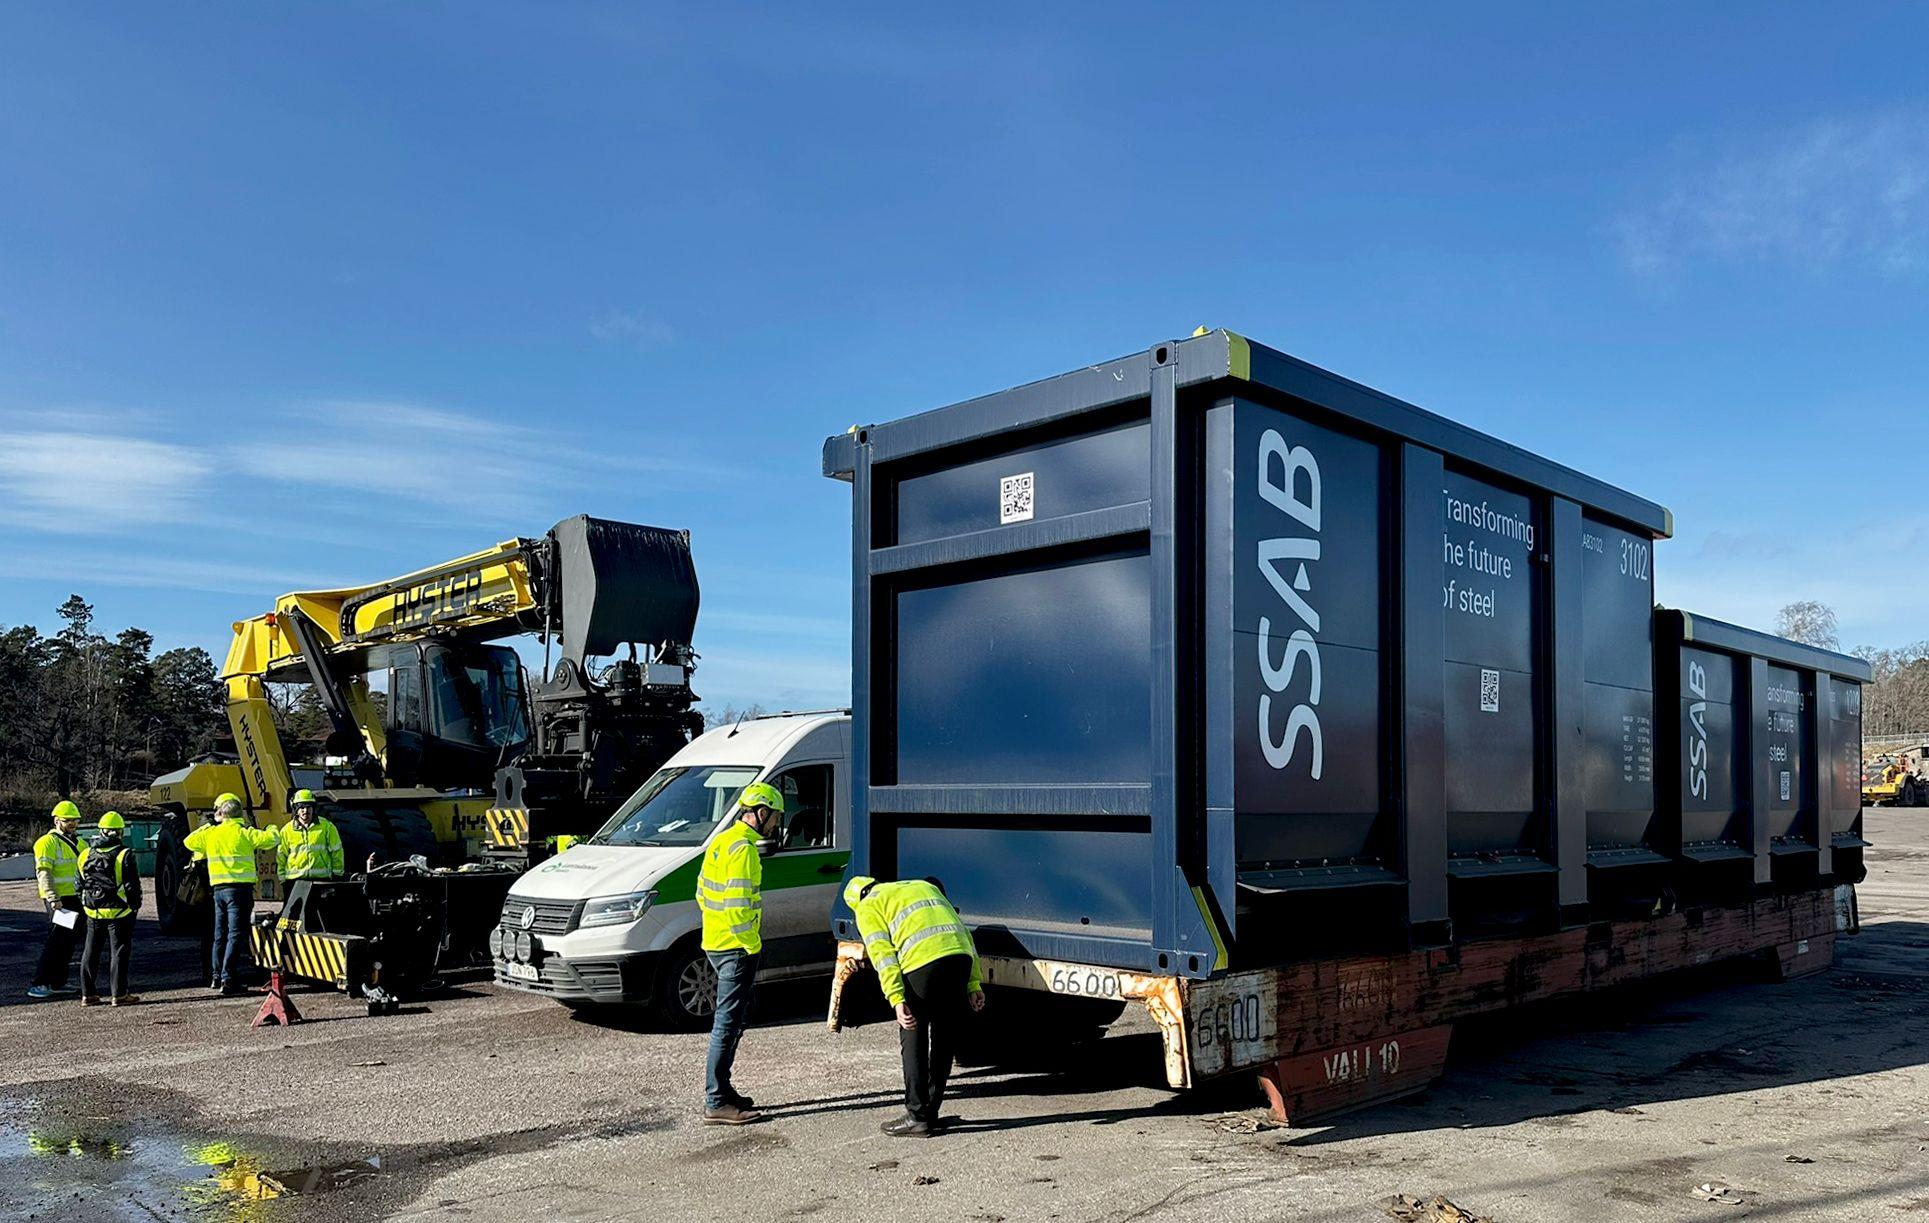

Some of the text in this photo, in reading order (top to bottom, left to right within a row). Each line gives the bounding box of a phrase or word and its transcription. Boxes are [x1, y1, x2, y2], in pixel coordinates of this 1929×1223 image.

[1443, 533, 1512, 579] he future
[1620, 538, 1648, 581] 3102
[393, 570, 482, 622] HYSTER
[1257, 428, 1323, 781] SSAB
[1459, 587, 1495, 618] steel
[1767, 683, 1805, 712] ansforming
[1689, 660, 1707, 801] SSAB
[1773, 711, 1795, 734] future
[238, 713, 267, 797] HYSTER
[1769, 742, 1788, 762] steel
[159, 786, 171, 801] 122
[1053, 969, 1116, 997] 6600
[1198, 994, 1259, 1048] 6600
[1378, 1040, 1400, 1075] 10
